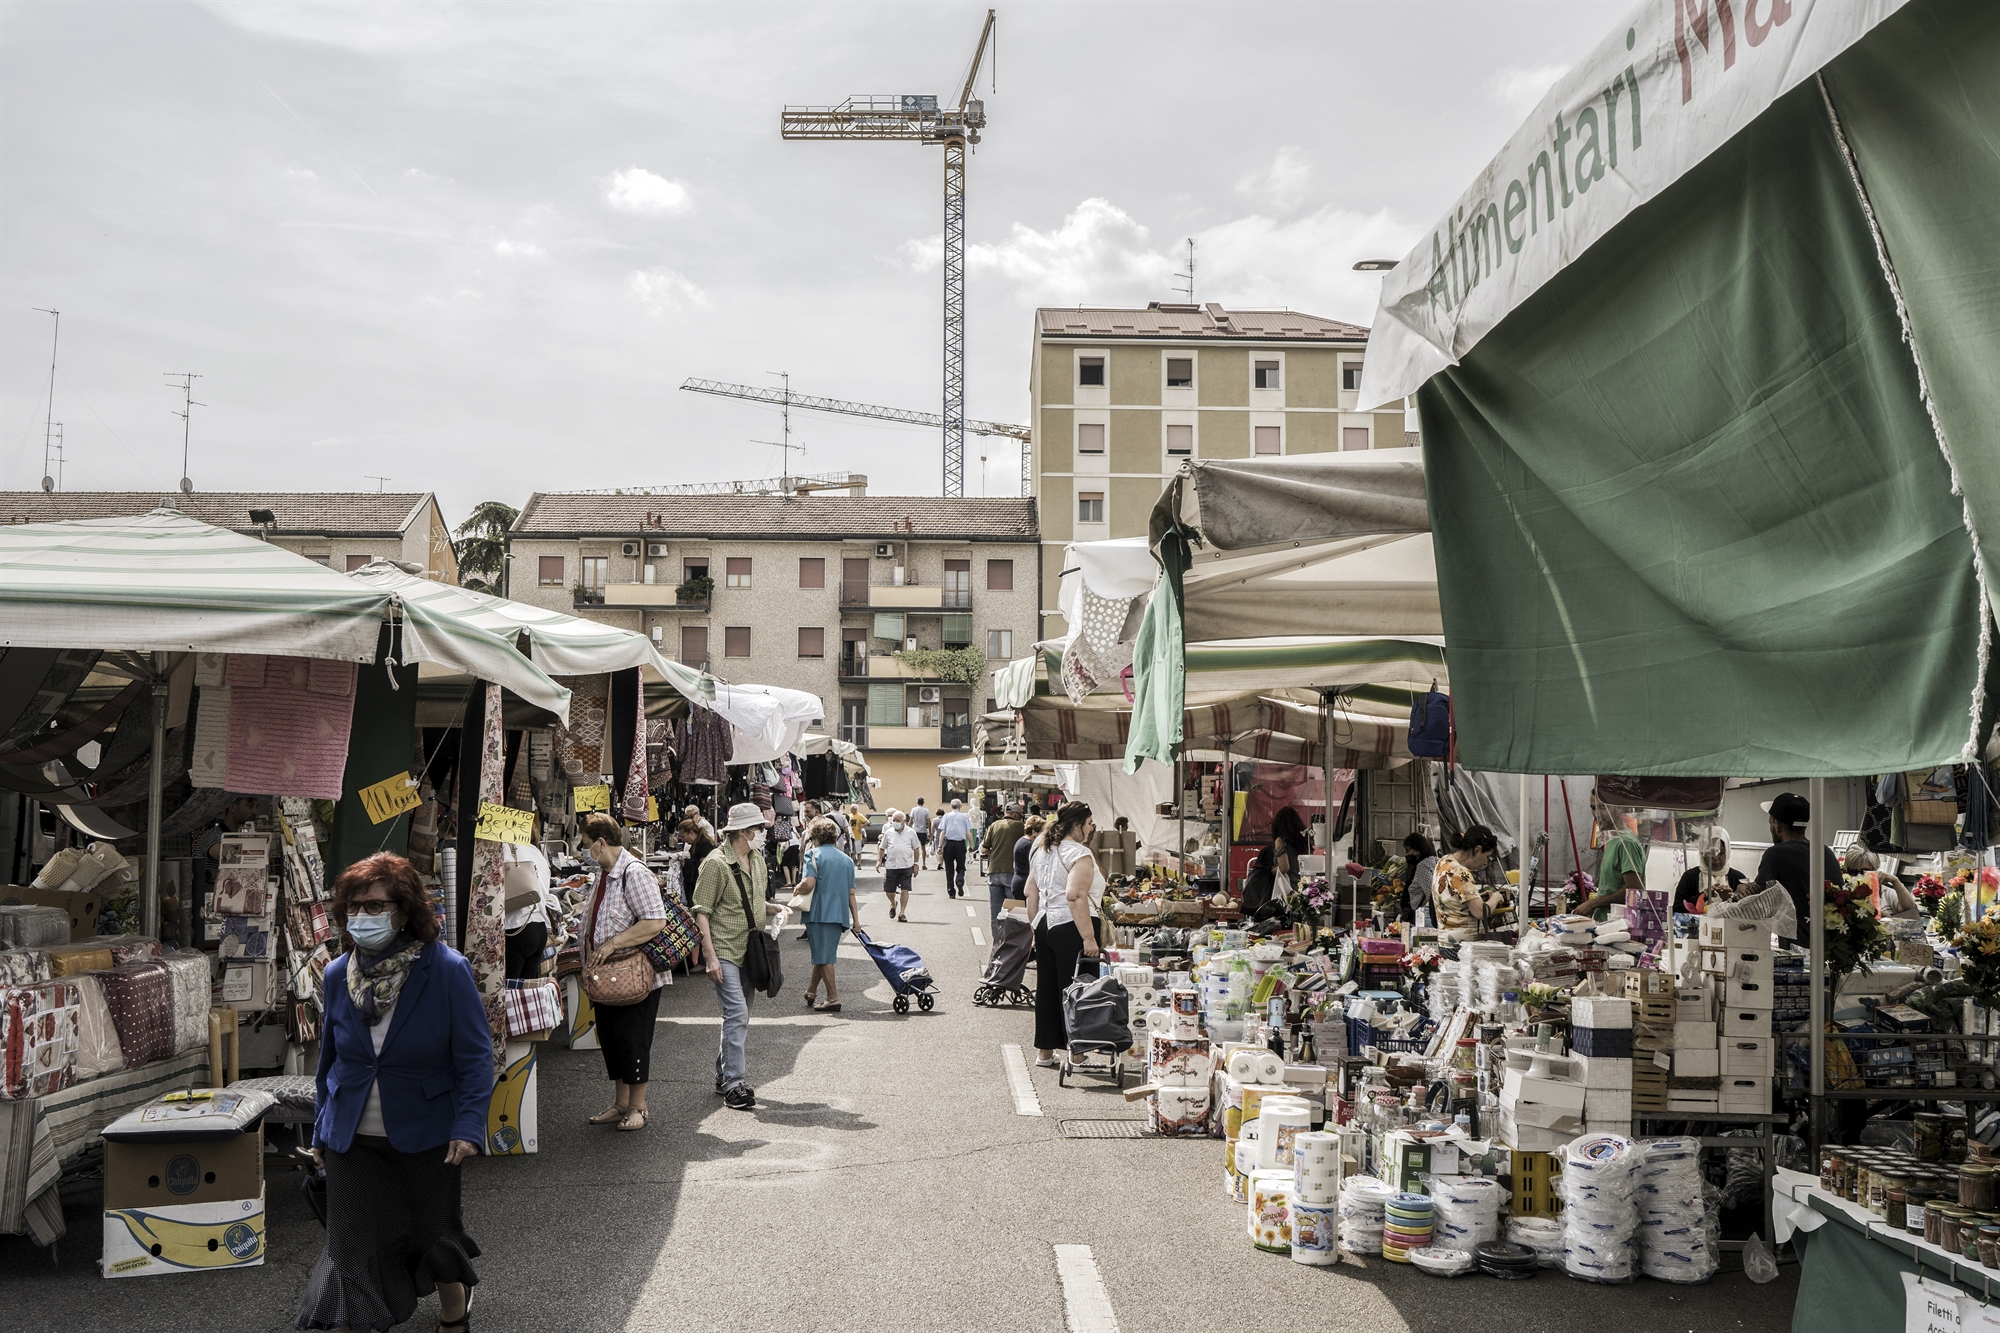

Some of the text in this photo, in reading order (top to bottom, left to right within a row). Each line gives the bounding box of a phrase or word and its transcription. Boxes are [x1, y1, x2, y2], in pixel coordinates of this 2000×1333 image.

[1427, 27, 1644, 322] Alimentari
[483, 803, 533, 820] SCONTATO
[167, 1173, 199, 1188] Chiquita
[1260, 1208, 1285, 1224] Girasole
[1273, 1220, 1289, 1228] XXL
[231, 1234, 258, 1256] Chiquita
[1927, 1301, 1952, 1321] Filetti
